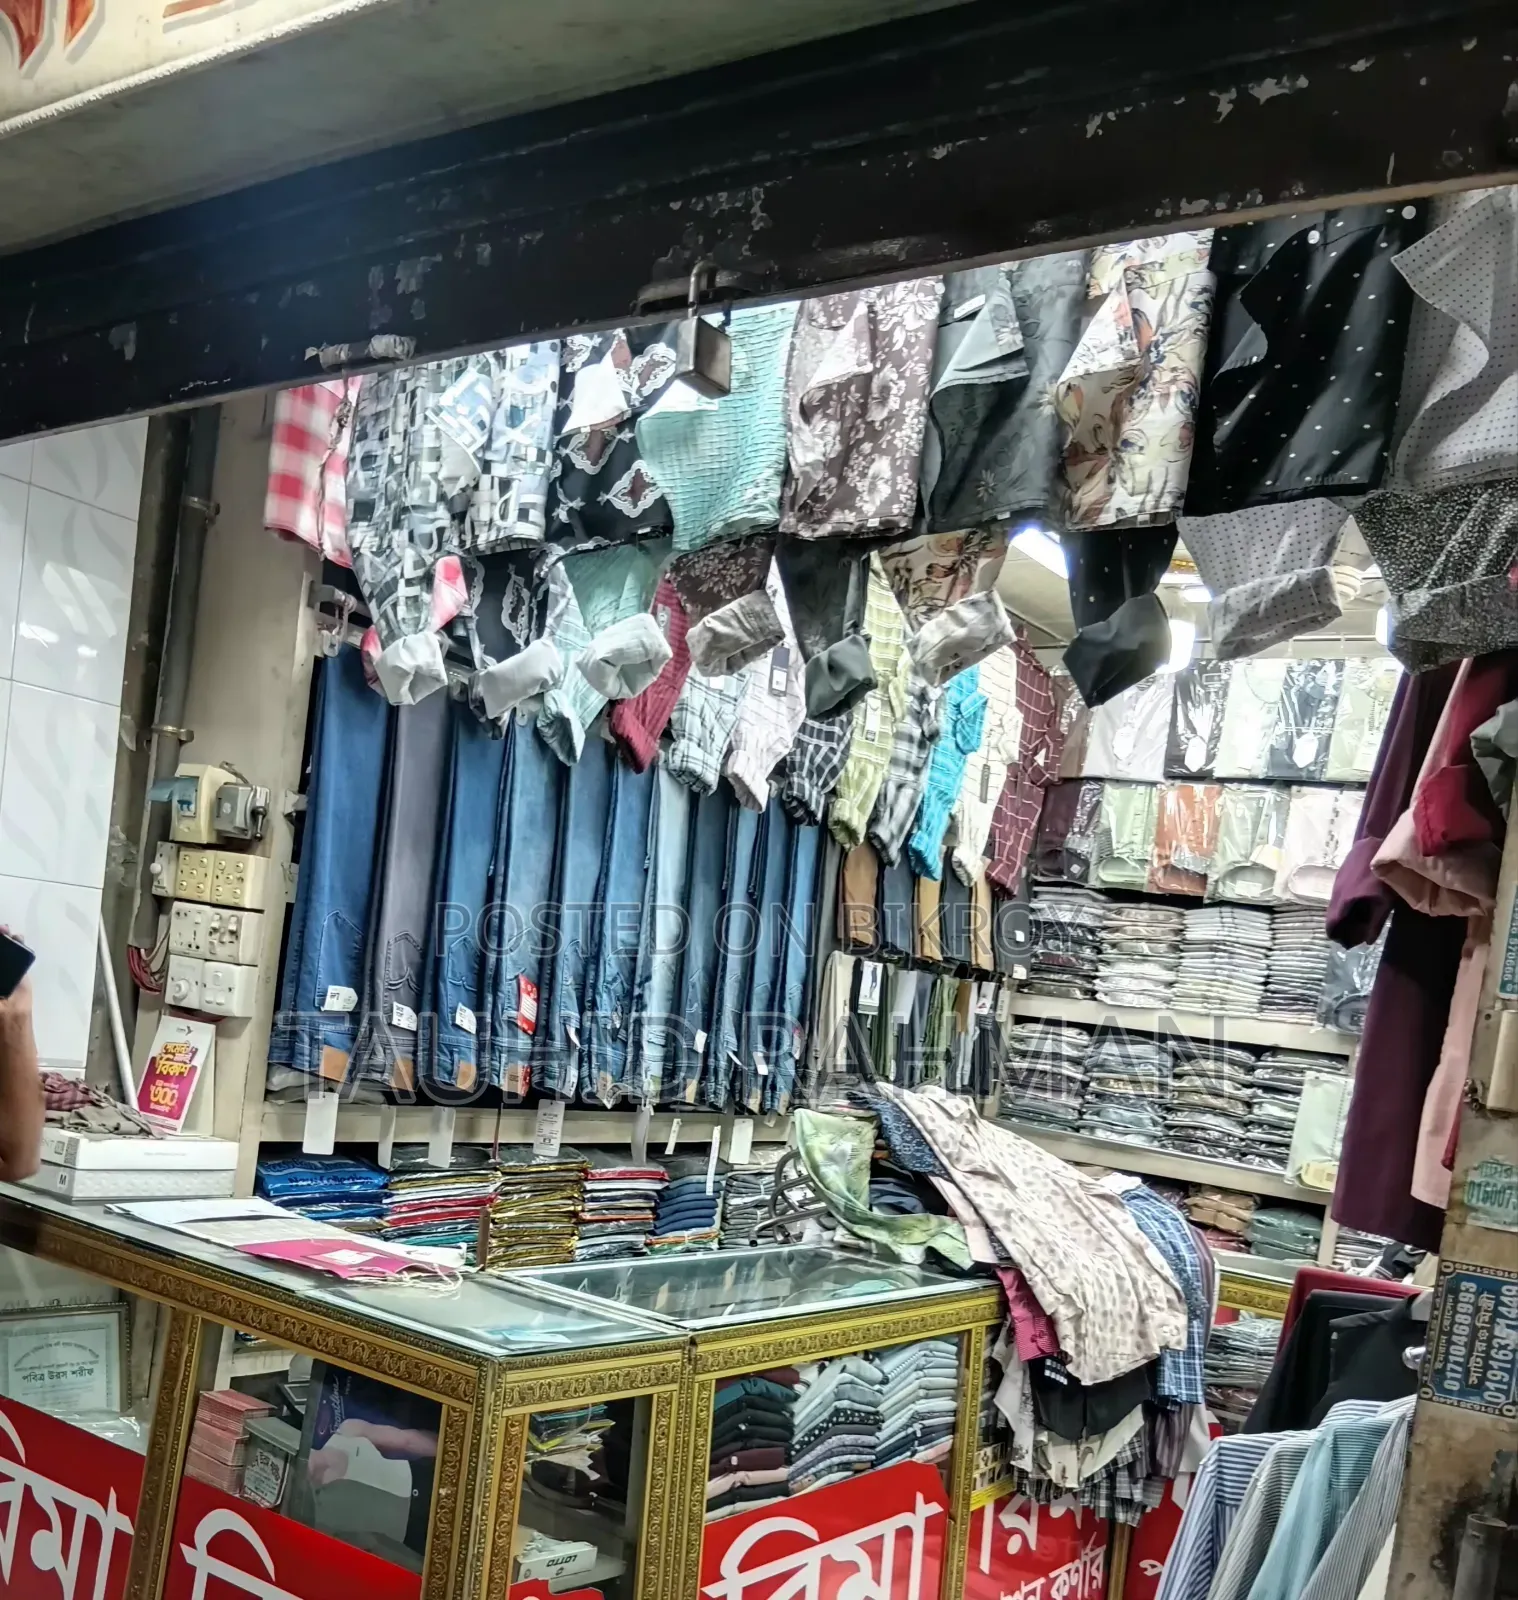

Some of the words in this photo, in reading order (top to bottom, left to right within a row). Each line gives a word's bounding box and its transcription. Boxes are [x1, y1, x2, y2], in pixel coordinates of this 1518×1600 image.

[59, 1174, 67, 1186] M
[1443, 1281, 1478, 1391] 01710468993
[546, 1555, 578, 1568] LOTTO
